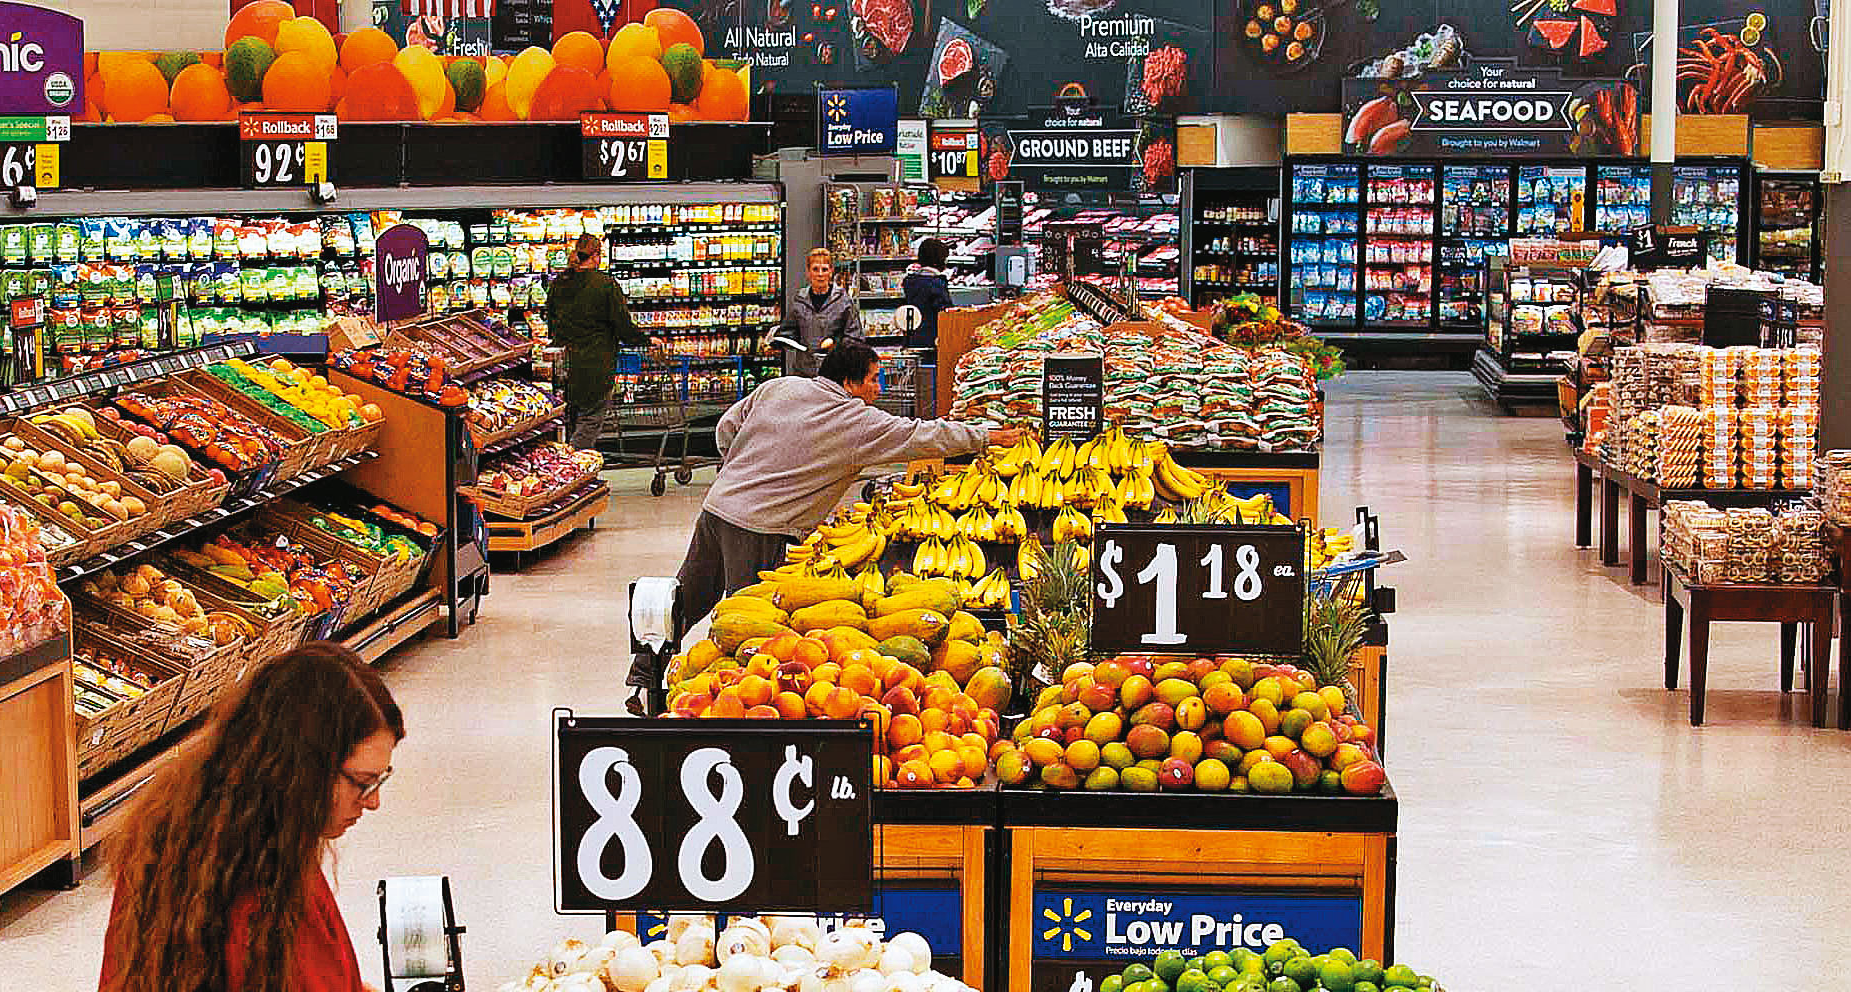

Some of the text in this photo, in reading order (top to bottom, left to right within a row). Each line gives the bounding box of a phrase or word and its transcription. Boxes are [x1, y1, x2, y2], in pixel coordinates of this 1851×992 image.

[1080, 13, 1154, 37] Premium
[724, 25, 796, 48] All Natural
[756, 52, 789, 66] Natural
[1085, 41, 1149, 58] Alta Calidad
[1480, 67, 1503, 76] Your
[1448, 78, 1536, 88] choice for natural
[1429, 100, 1554, 121] SEAFOOD
[262, 121, 311, 134] Rollback
[601, 119, 645, 132] Rollback
[828, 132, 852, 144] Low
[854, 129, 883, 144] Price
[600, 139, 646, 176] $267
[1019, 138, 1131, 158] GROUND BEEF
[255, 143, 305, 183] 92¢
[385, 248, 420, 294] Organic
[1049, 406, 1096, 420] FRESH
[1097, 540, 1262, 644] $118
[830, 776, 856, 799] lb.
[576, 744, 815, 902] 88¢
[1106, 898, 1172, 915] Everyday
[1106, 913, 1284, 946] Low Price
[1106, 946, 1129, 955] Precio
